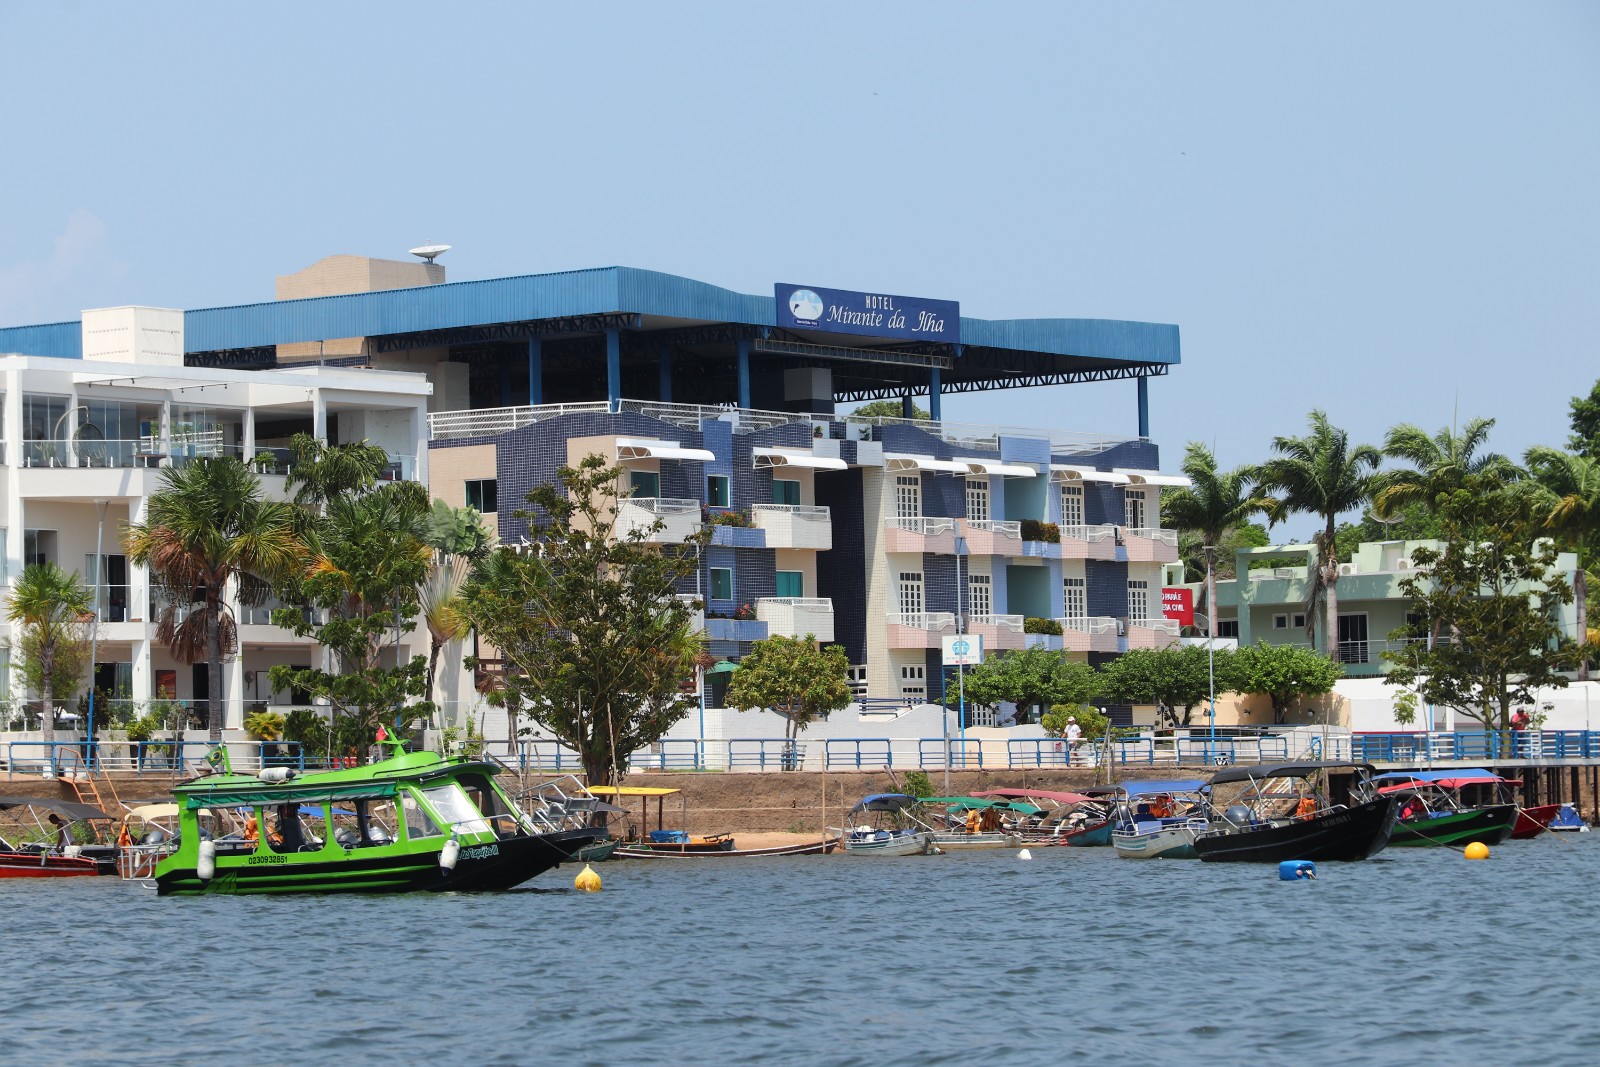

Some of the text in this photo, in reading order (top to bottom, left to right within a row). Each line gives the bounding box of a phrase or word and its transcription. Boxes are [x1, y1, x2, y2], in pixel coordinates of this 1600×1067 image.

[866, 295, 893, 310] HOTEL
[827, 305, 944, 332] Mirante da Ilha
[248, 856, 288, 864] 0230932851
